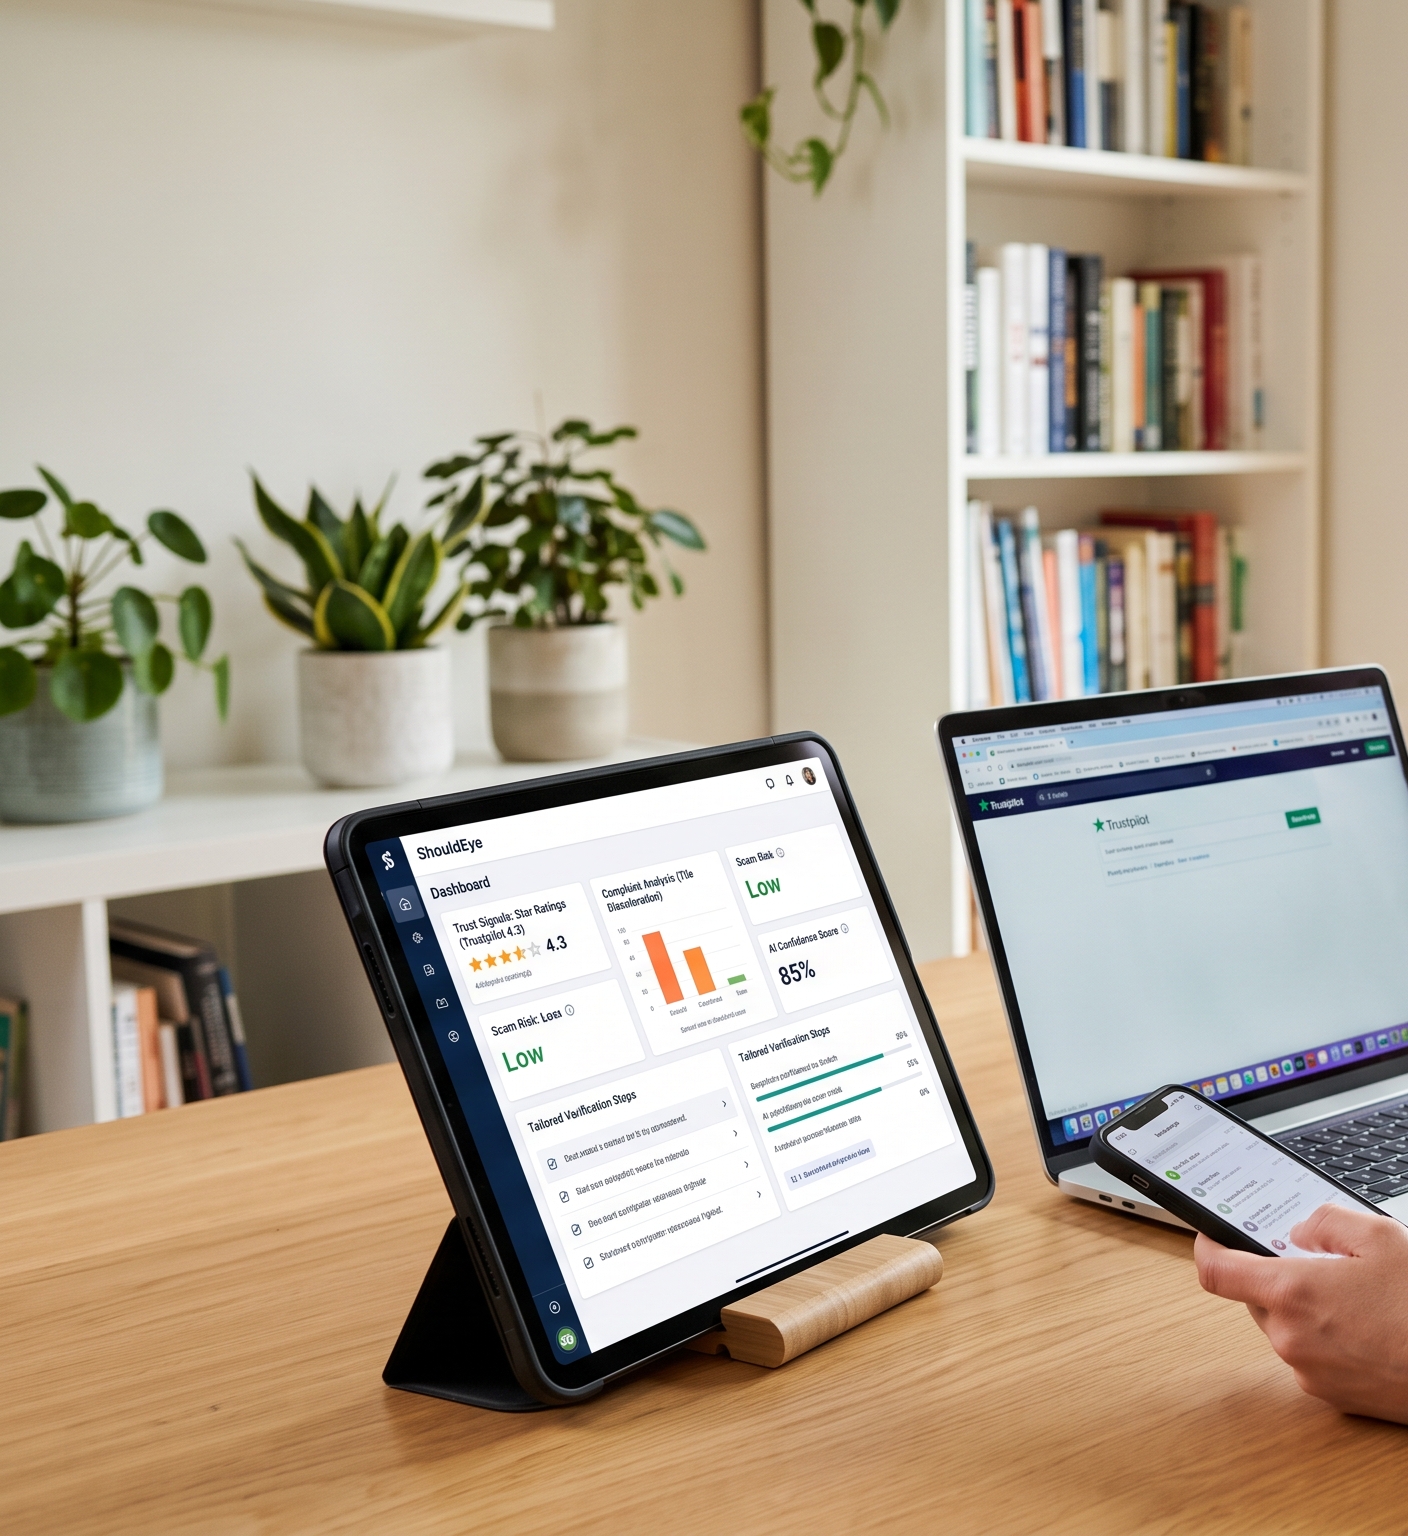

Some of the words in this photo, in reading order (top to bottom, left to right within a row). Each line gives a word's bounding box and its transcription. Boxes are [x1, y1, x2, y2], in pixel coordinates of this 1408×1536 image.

[417, 838, 483, 860] ShouldEye
[735, 856, 758, 867] Scam
[430, 875, 491, 899] Dashboard
[745, 878, 781, 899] Low
[452, 920, 478, 933] Trust
[514, 908, 532, 919] Star
[533, 901, 567, 914] Ratings
[507, 924, 525, 936] 4.3)
[547, 935, 567, 952] 4.3
[778, 960, 816, 985] 85%
[491, 1023, 517, 1036] Scam
[517, 1015, 540, 1029] Risk:
[502, 1046, 543, 1072] Low
[738, 1044, 769, 1062] Tailored
[527, 1112, 564, 1132] Tailored
